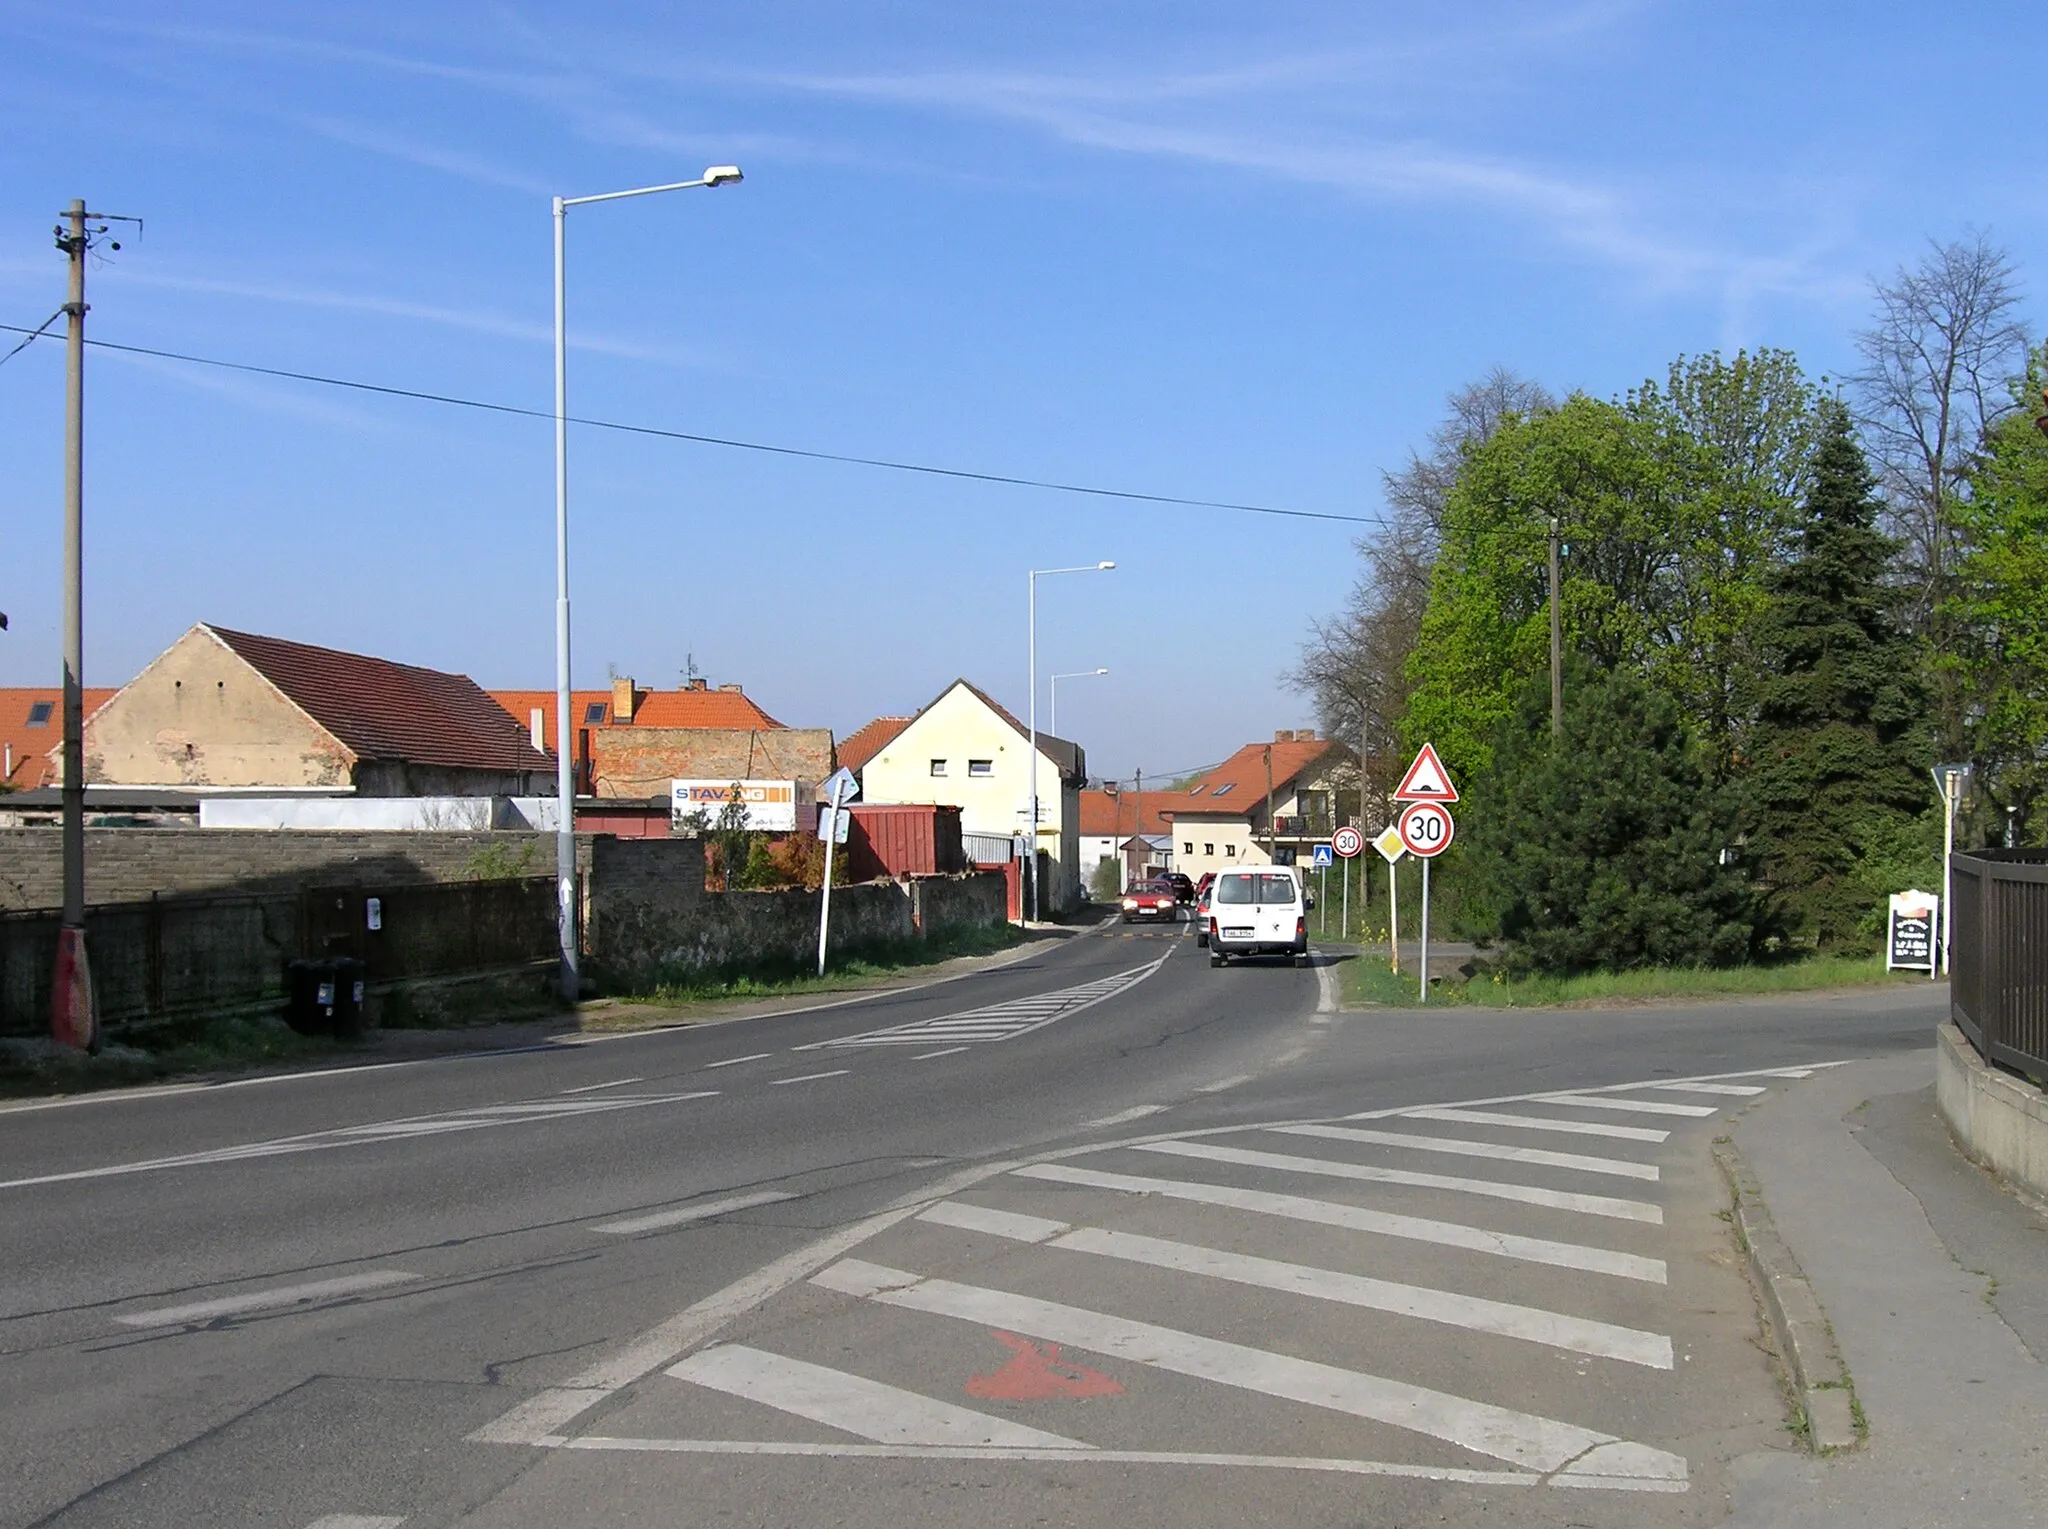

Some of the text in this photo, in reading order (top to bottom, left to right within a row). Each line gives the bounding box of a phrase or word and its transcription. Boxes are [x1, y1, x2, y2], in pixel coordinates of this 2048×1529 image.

[676, 788, 765, 800] STAV-NG
[1411, 816, 1441, 841] 30
[1339, 835, 1356, 849] 30
